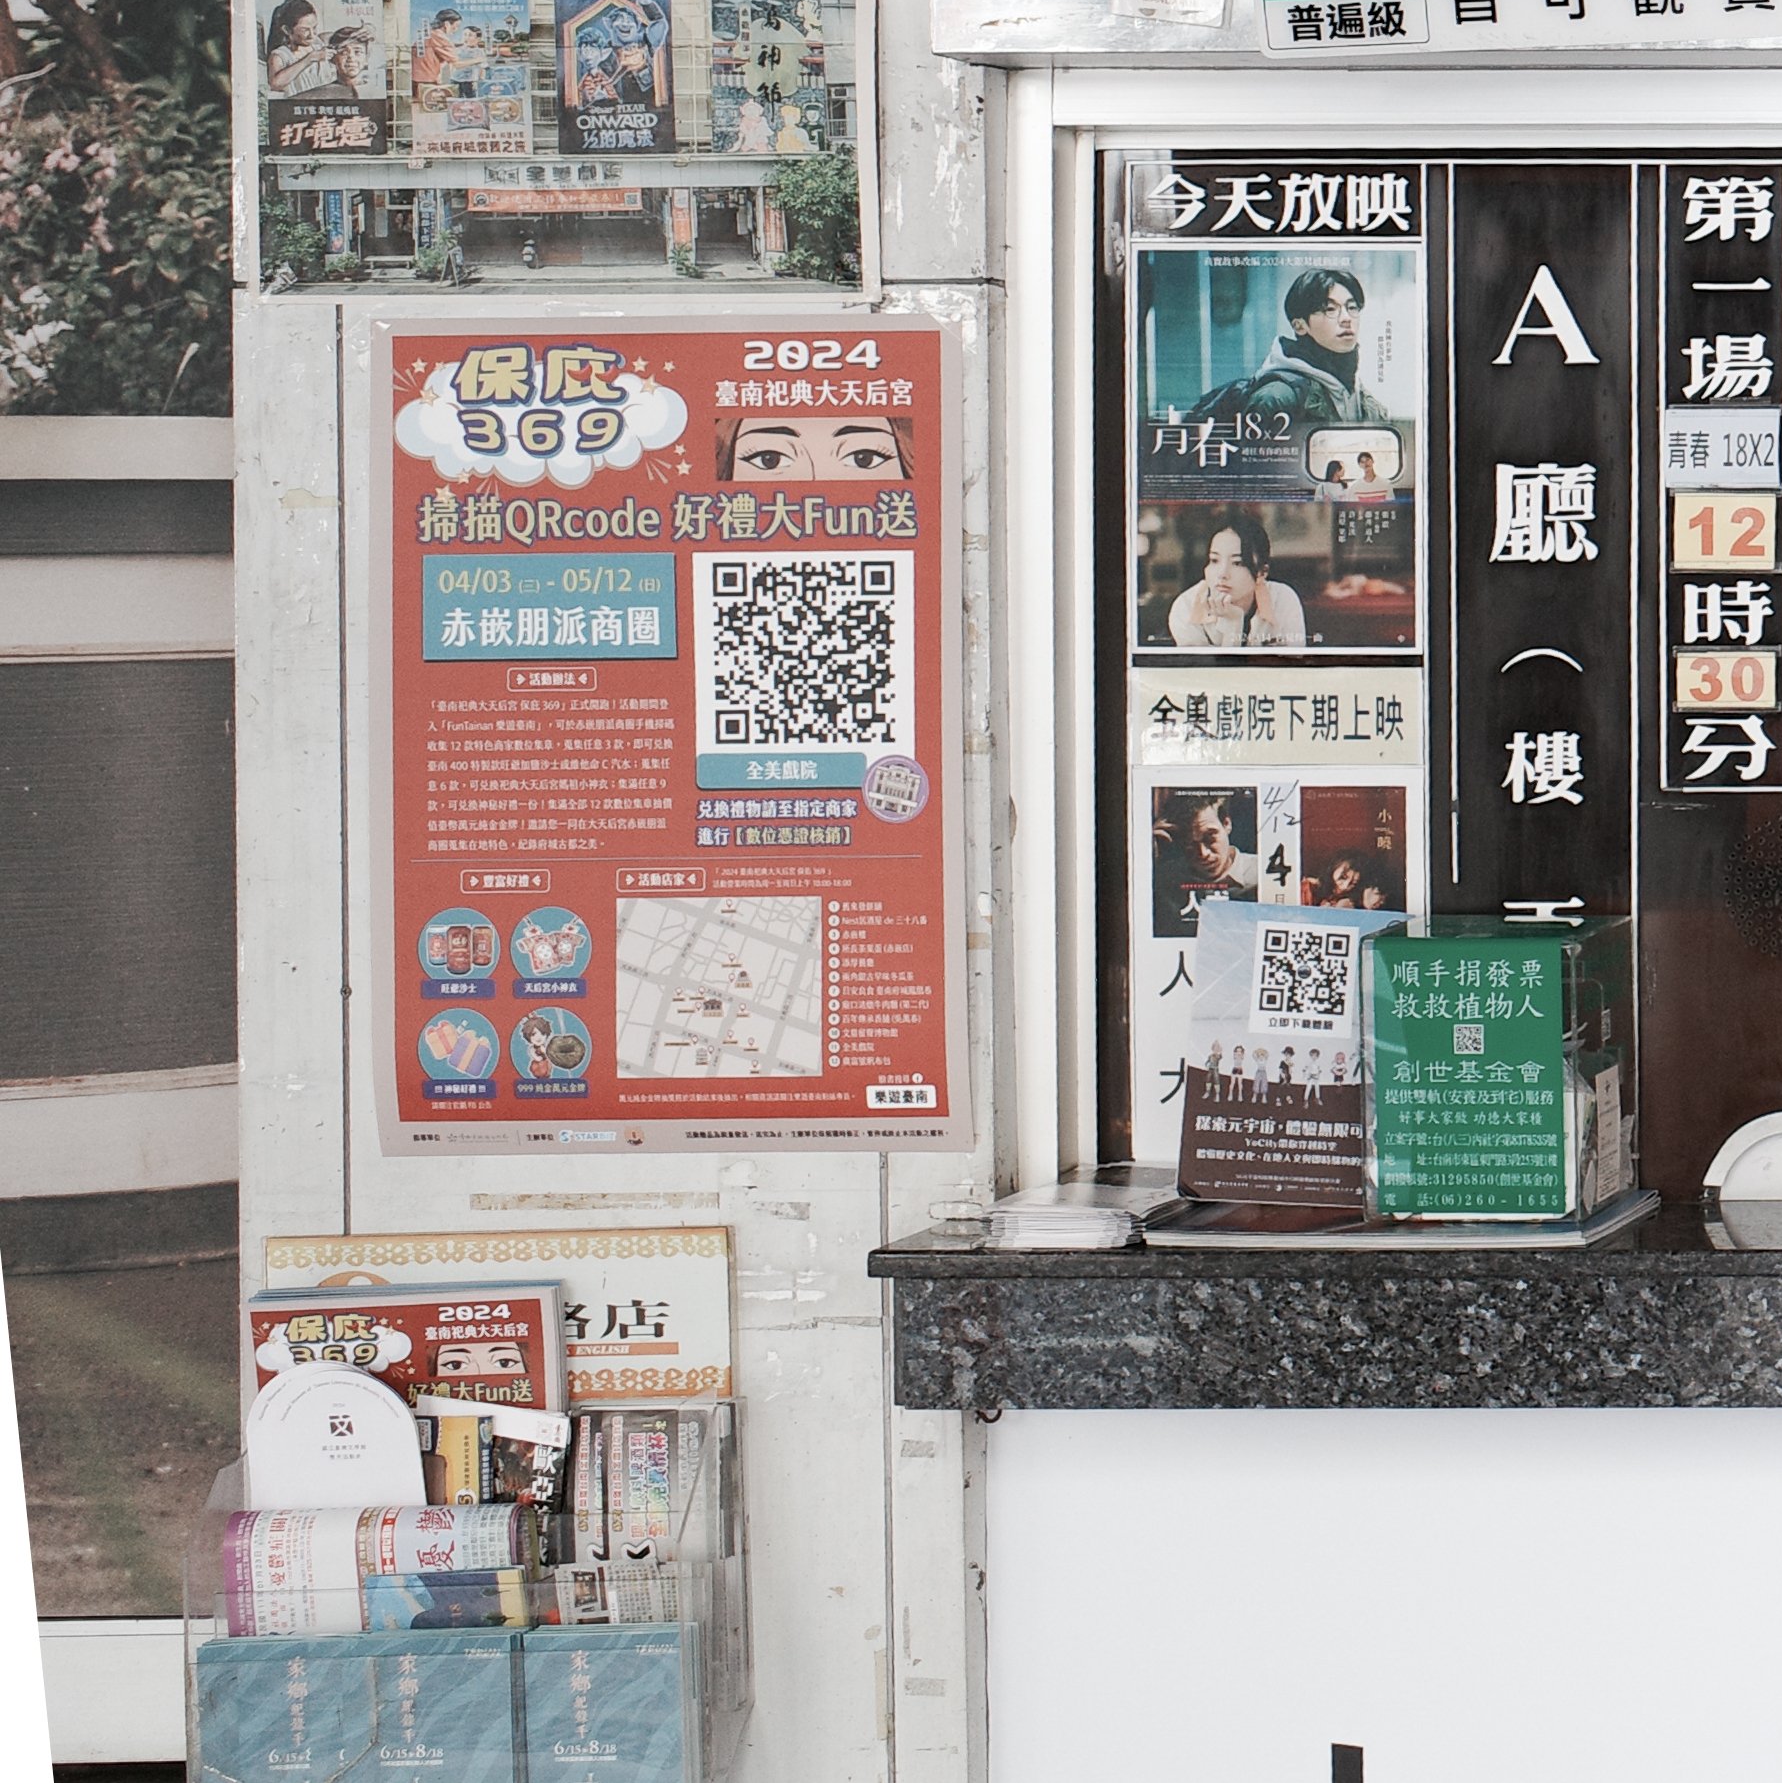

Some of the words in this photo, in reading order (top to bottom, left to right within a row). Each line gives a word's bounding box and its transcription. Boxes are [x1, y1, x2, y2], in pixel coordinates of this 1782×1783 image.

[1285, 0, 1408, 43] 普遍級
[576, 113, 658, 130] ONWARD
[1146, 173, 1413, 234] 今天放映
[1681, 175, 1775, 401] 第一場
[742, 339, 882, 371] 2024
[453, 343, 627, 406] 保庇
[714, 378, 914, 408] 臺南祀典大天后宮
[460, 409, 624, 455] 369
[1148, 404, 1241, 468] 青春
[1667, 430, 1711, 469] 青春
[1722, 432, 1776, 469] 18X2
[416, 495, 662, 546] 掃描QRcode
[672, 491, 918, 542] 好禮大Fun送
[1688, 507, 1767, 557] 12
[438, 568, 512, 595] 04/03
[563, 567, 634, 594] 05/12
[440, 606, 662, 648] 赤嵌朋派商圈
[528, 671, 577, 687] 活動辦法
[1689, 656, 1765, 702] 30
[746, 761, 818, 780] 全美戲院
[697, 799, 857, 819] 兌換禮物請至指定商家
[697, 826, 851, 847] 進行【數位憑證核銷】
[638, 872, 686, 888] 活動店家
[1391, 959, 1544, 989] 順手捐發票
[1391, 992, 1545, 1020] 救救植物人
[1393, 1060, 1546, 1083] 創世基金會
[874, 1088, 929, 1106] 樂遊臺南
[285, 1313, 376, 1341] 保庇
[438, 1304, 511, 1322] 2024
[425, 1323, 529, 1341] 臺南祀典大天后宮
[573, 1344, 630, 1356] ENGLISH
